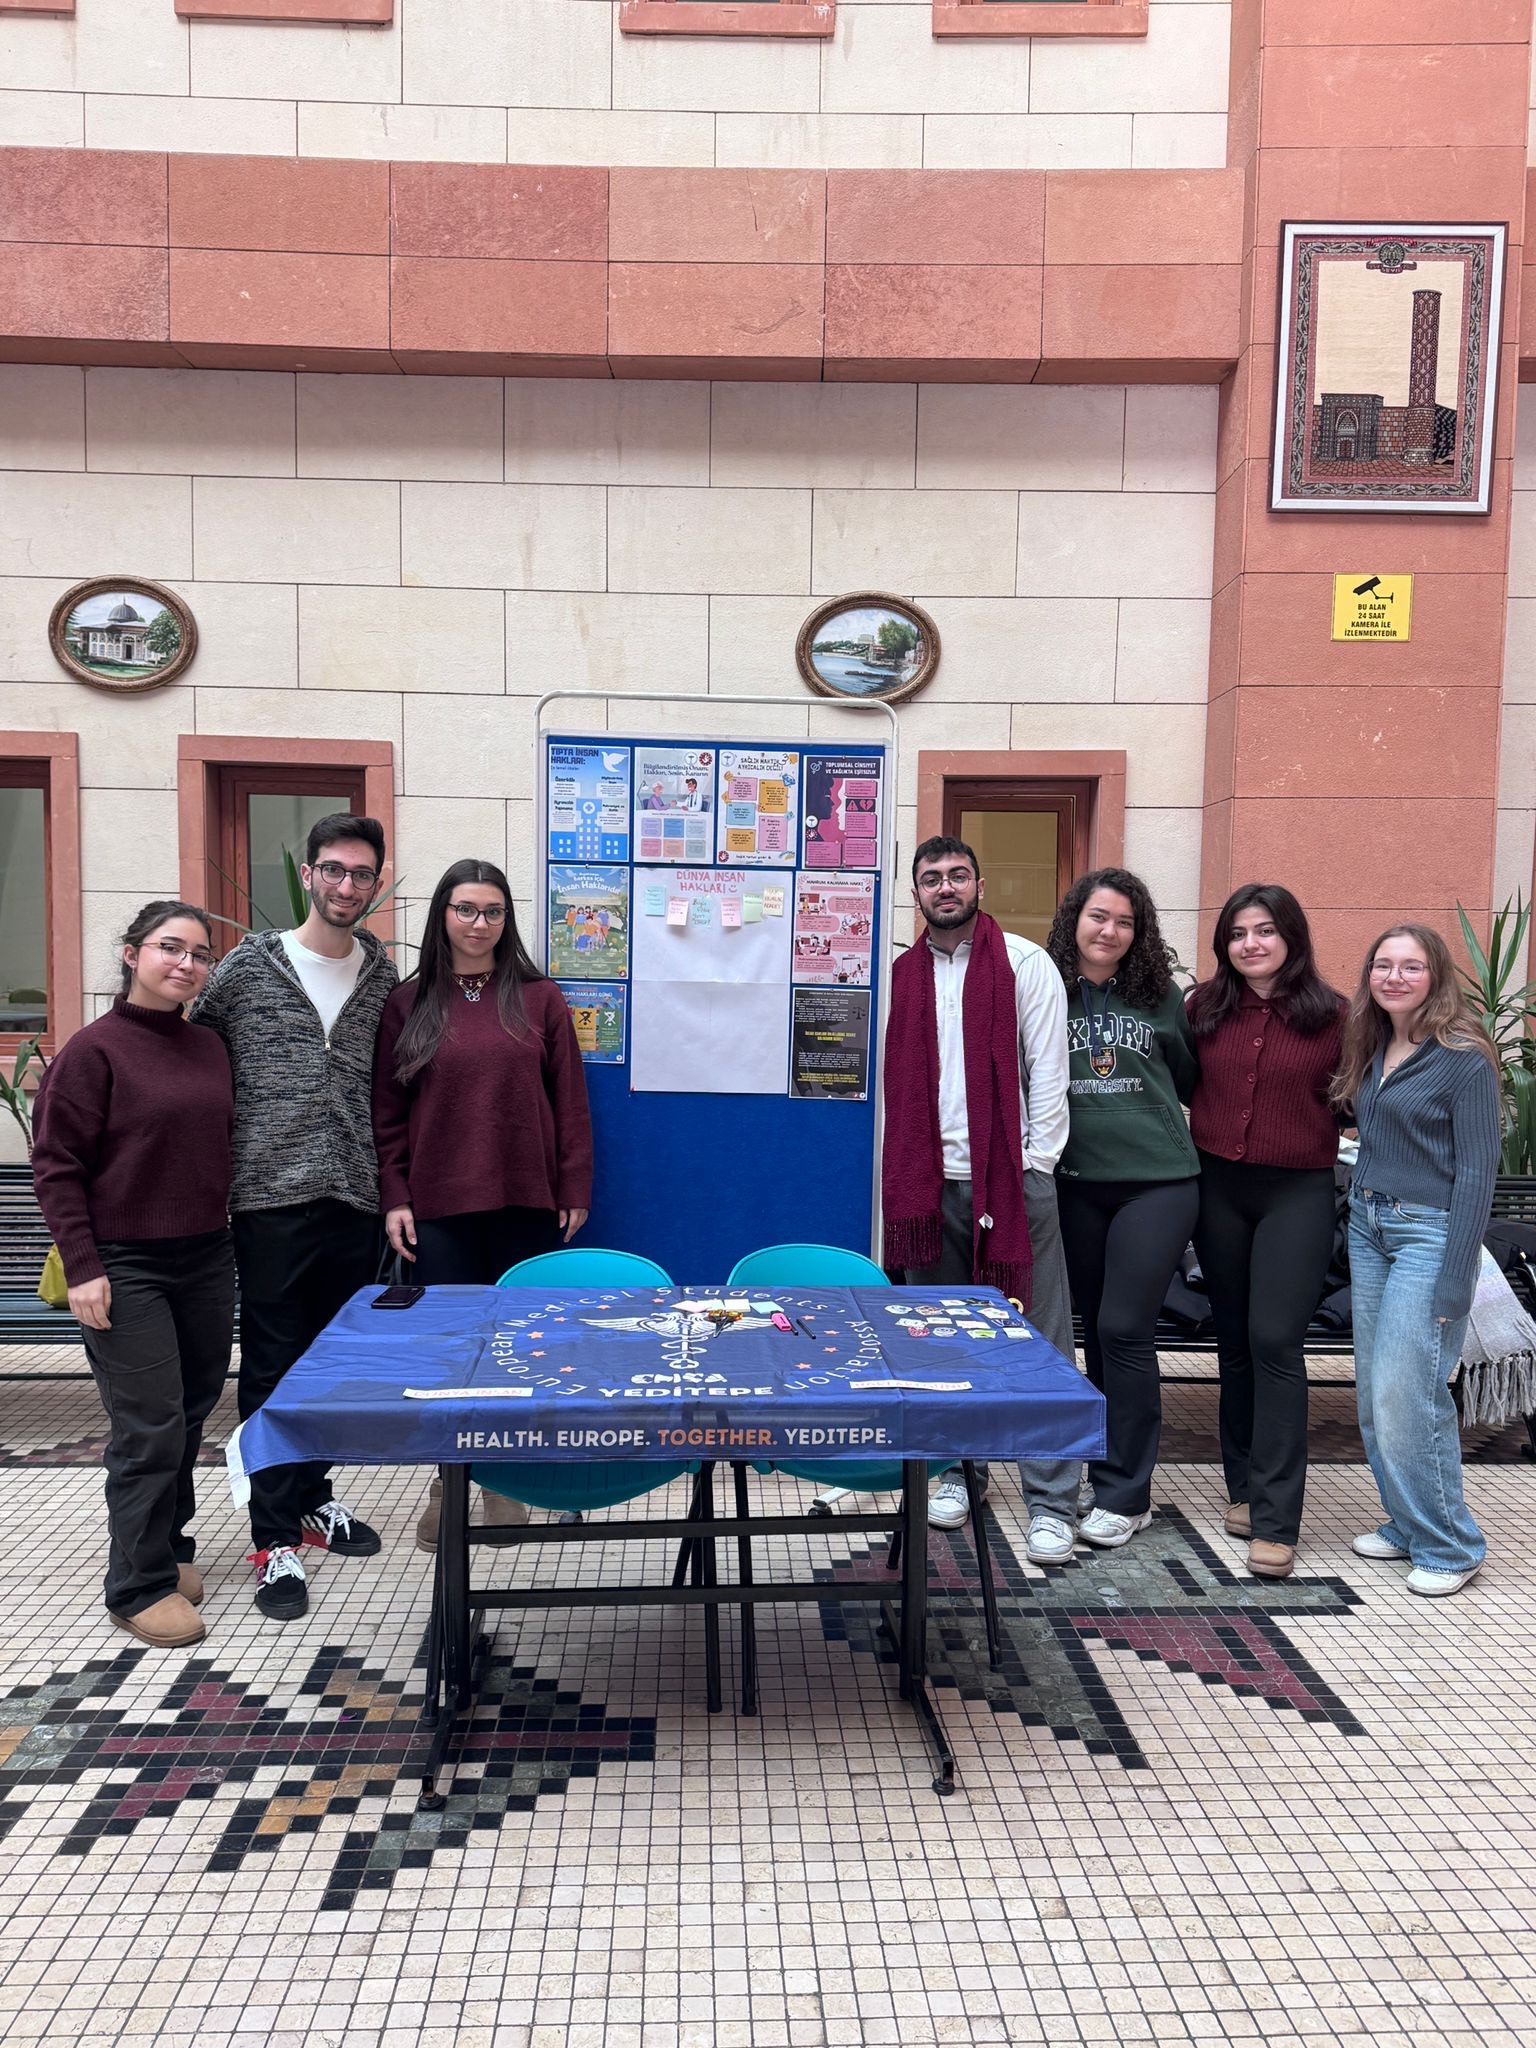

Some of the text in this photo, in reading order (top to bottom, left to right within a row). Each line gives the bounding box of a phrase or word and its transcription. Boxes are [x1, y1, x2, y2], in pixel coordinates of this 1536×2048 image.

[1344, 629, 1397, 637] İZLENMEKTEDİR
[680, 882, 726, 893] HAKLARI
[1067, 1012, 1154, 1059] XFORD
[504, 1290, 635, 1328] Medical
[491, 1331, 587, 1396] European
[784, 1320, 883, 1390] Association
[457, 1428, 893, 1448] HEALTH. EUROPE. TOGETHER. YEDITEPE.
